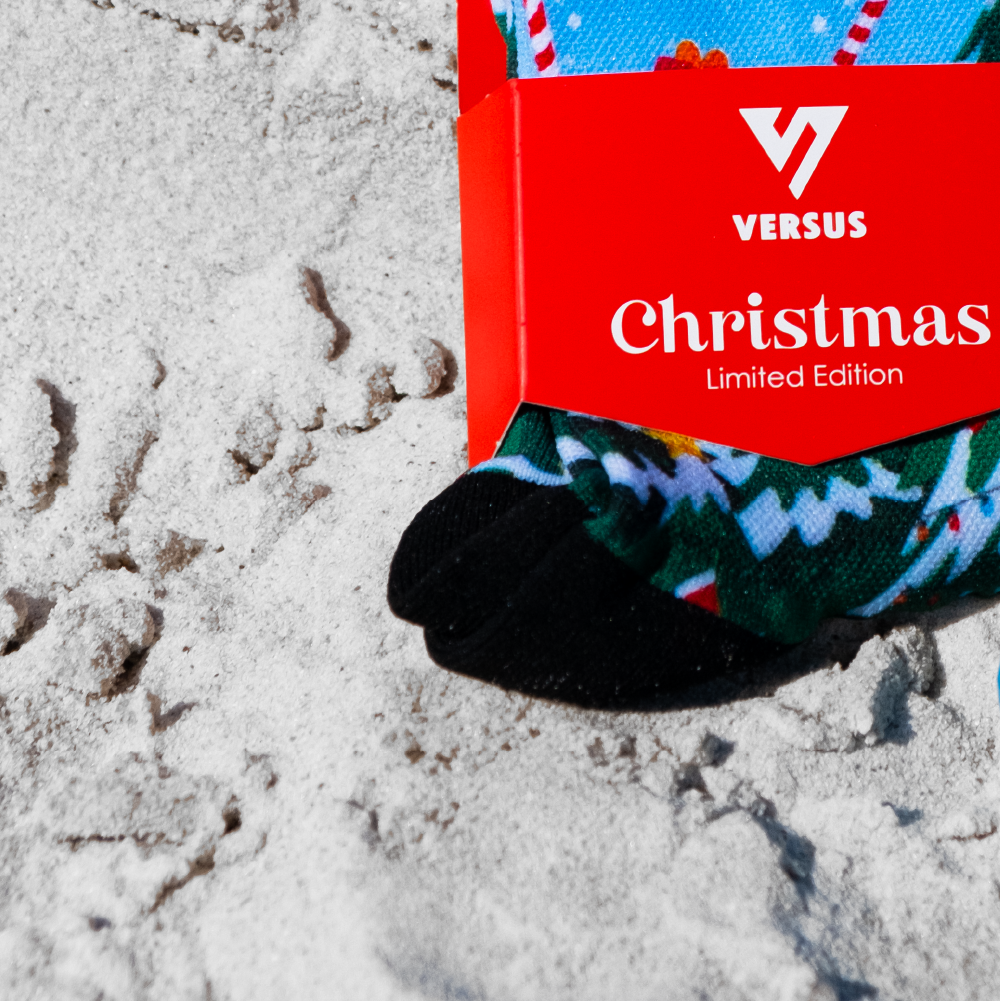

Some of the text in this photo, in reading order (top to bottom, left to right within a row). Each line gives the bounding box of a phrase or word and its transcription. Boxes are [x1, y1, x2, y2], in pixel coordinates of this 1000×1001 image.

[732, 211, 867, 241] VERSUS
[610, 292, 991, 355] Christmas
[706, 362, 903, 390] Limited Edition
